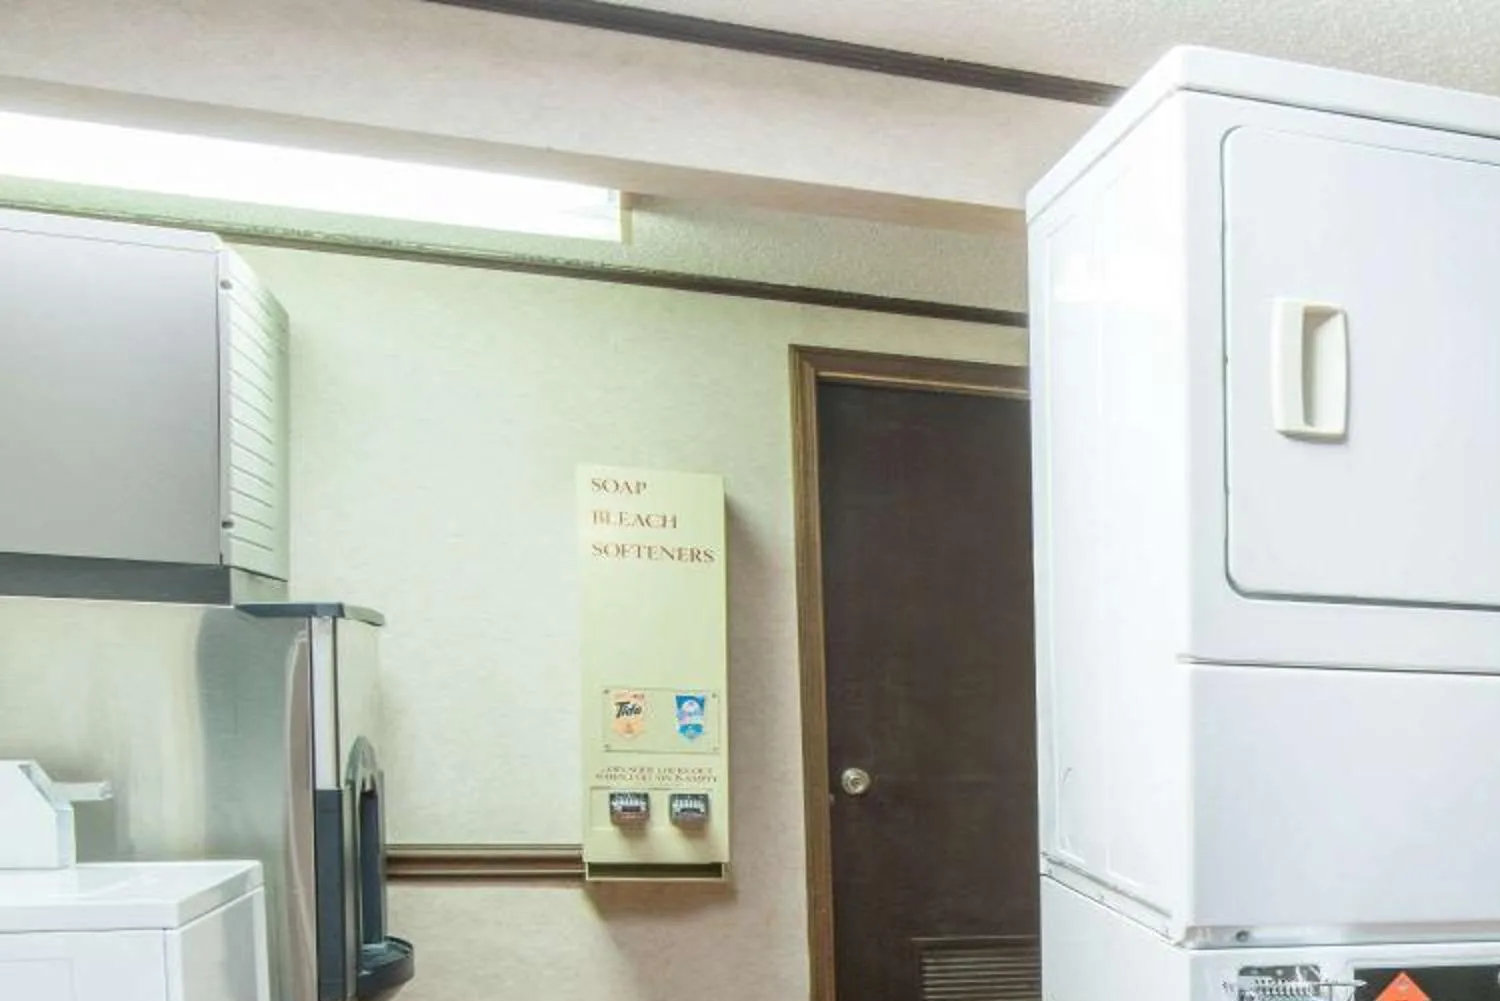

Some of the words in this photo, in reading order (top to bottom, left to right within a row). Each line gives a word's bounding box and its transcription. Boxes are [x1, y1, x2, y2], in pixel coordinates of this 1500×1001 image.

[591, 477, 647, 495] SOAP
[591, 509, 678, 529] BLEACH
[591, 543, 716, 563] SOFTENERS
